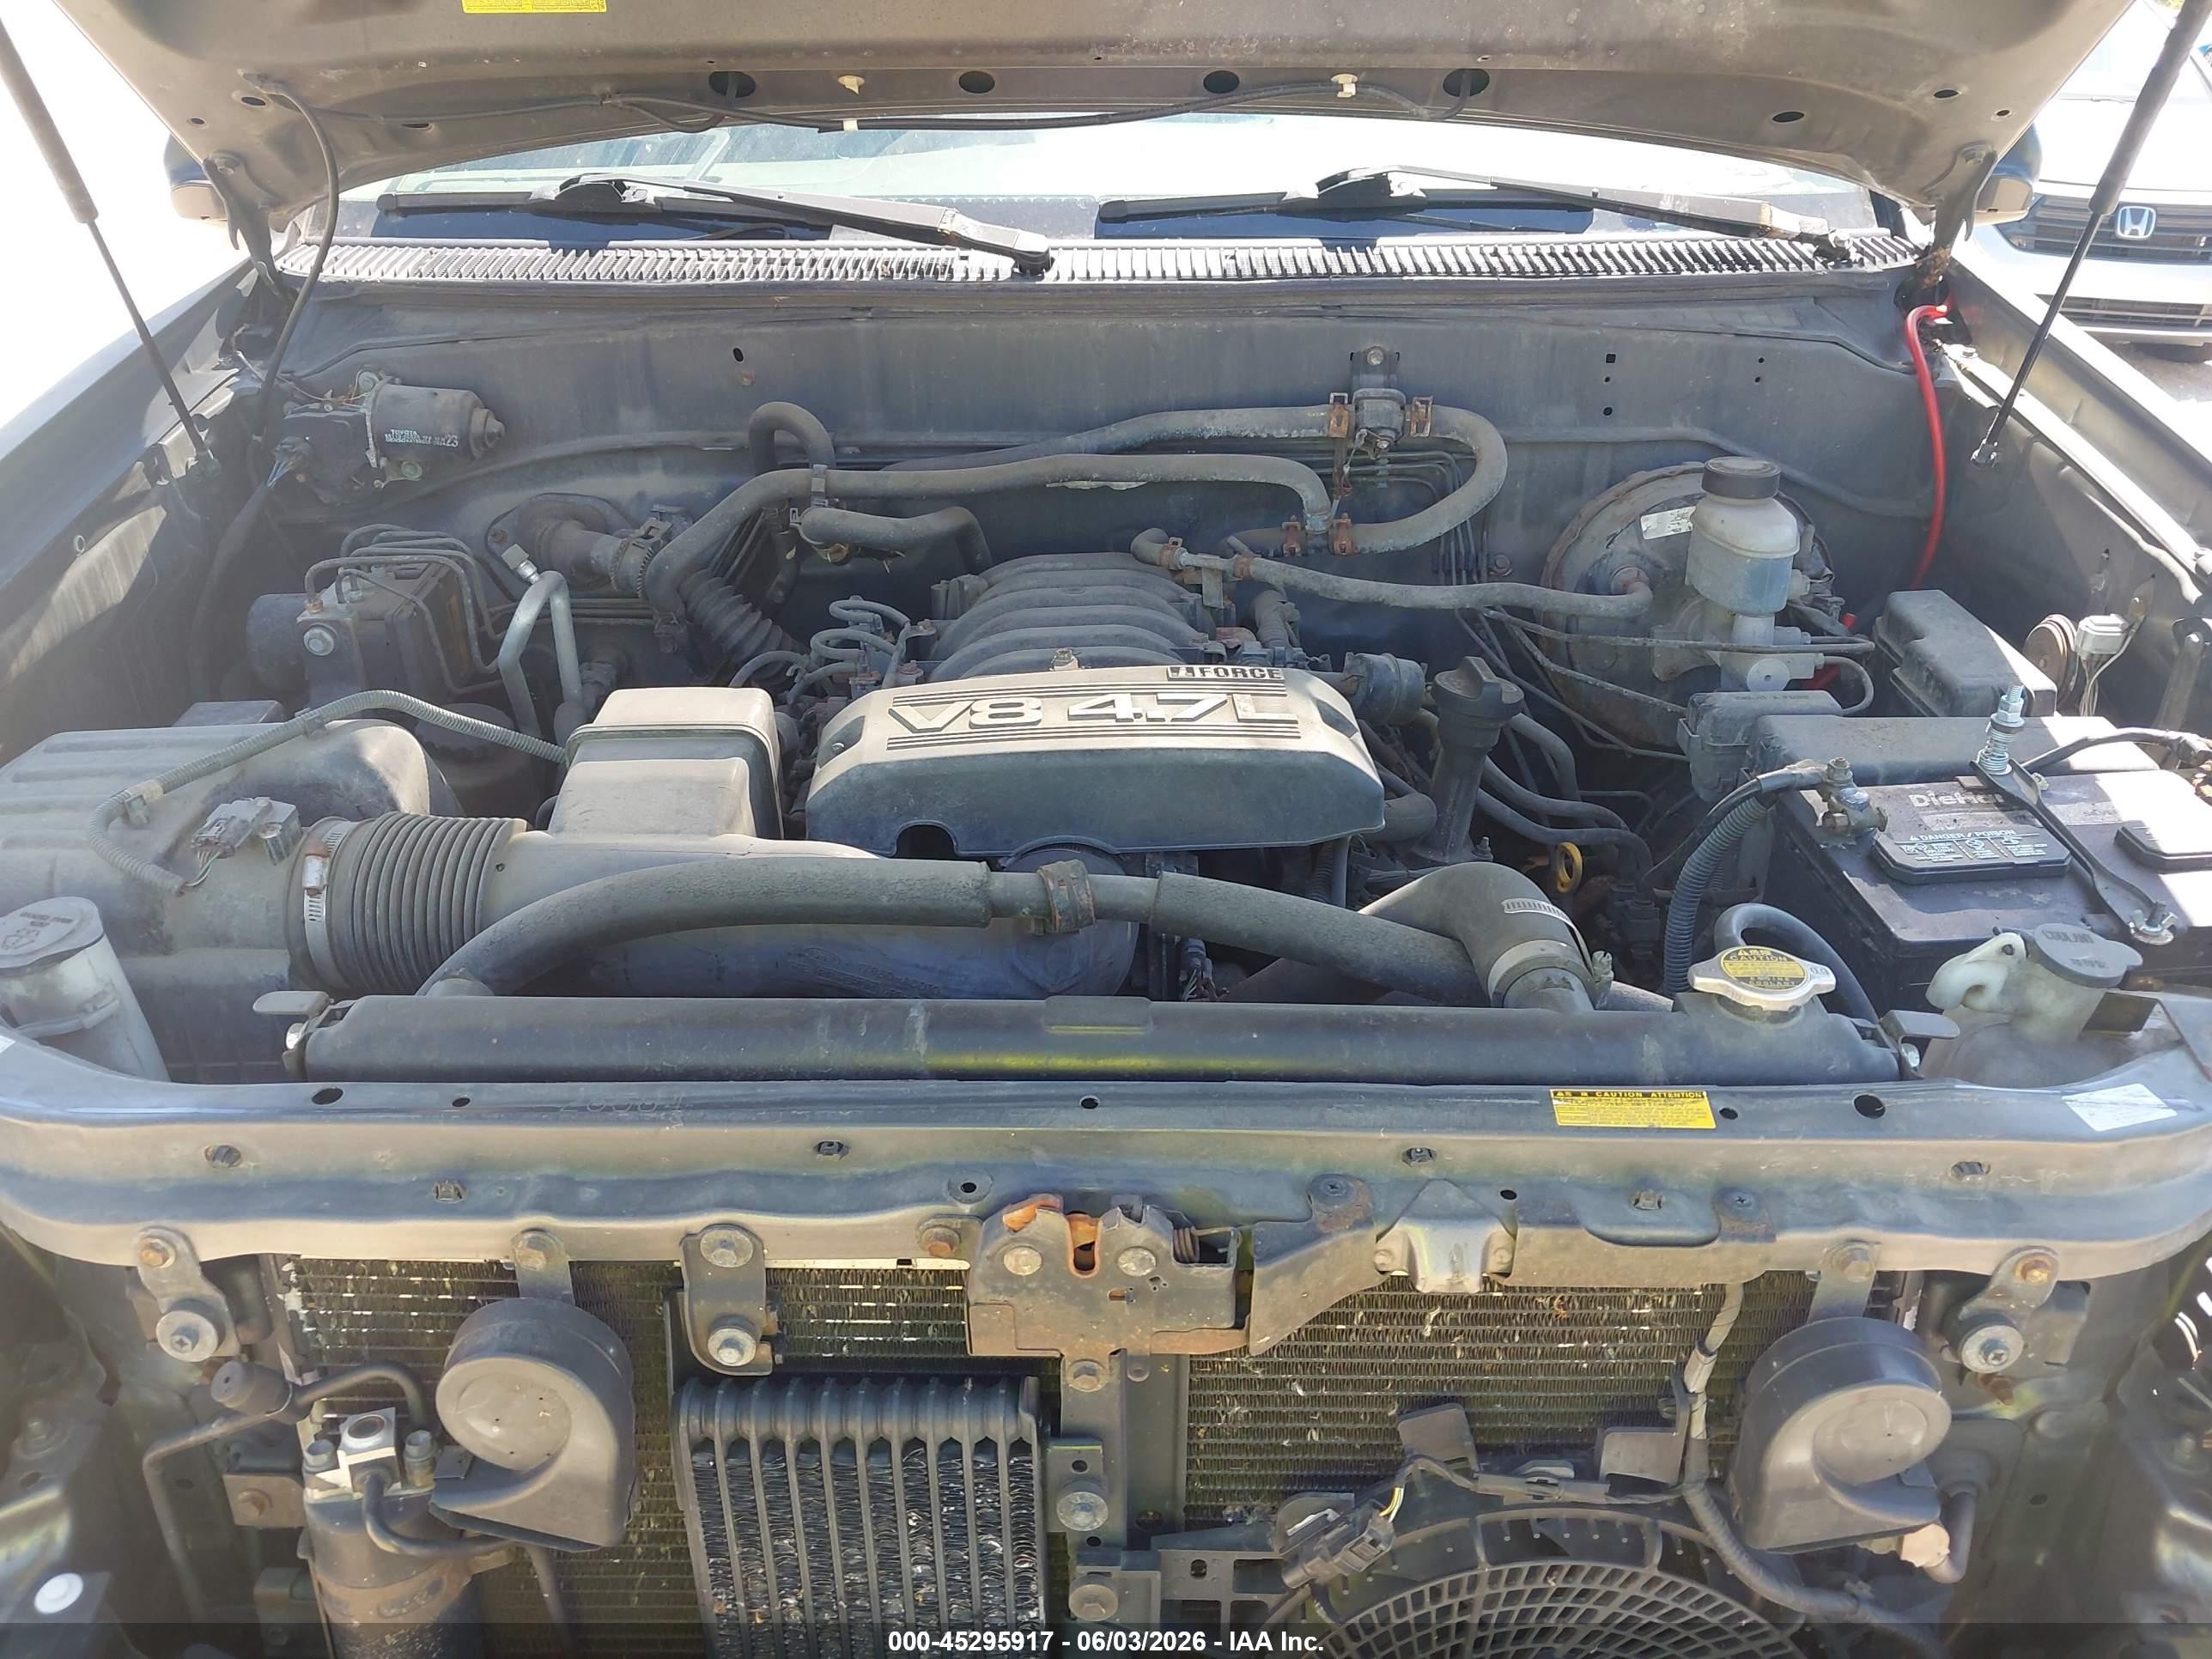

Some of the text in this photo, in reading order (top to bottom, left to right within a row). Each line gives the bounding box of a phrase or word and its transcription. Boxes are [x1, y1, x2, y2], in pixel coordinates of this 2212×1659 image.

[888, 691, 1299, 734] V8 4.7L
[1919, 832, 1964, 842] DANGER
[1974, 830, 2017, 838] POISON
